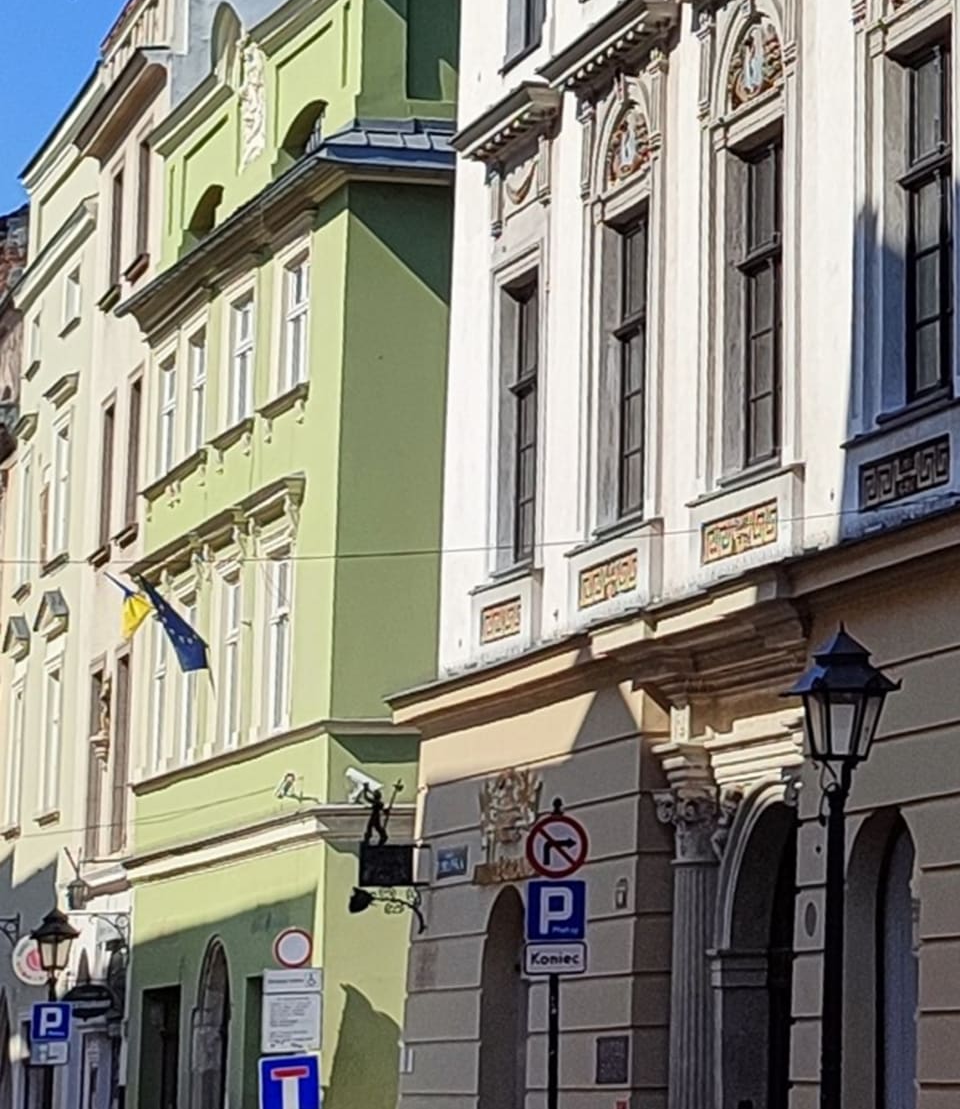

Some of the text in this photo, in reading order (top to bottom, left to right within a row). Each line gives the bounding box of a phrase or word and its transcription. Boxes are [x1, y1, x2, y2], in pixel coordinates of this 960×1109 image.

[540, 886, 573, 934] P
[530, 952, 580, 965] Koniec
[40, 1006, 62, 1036] P
